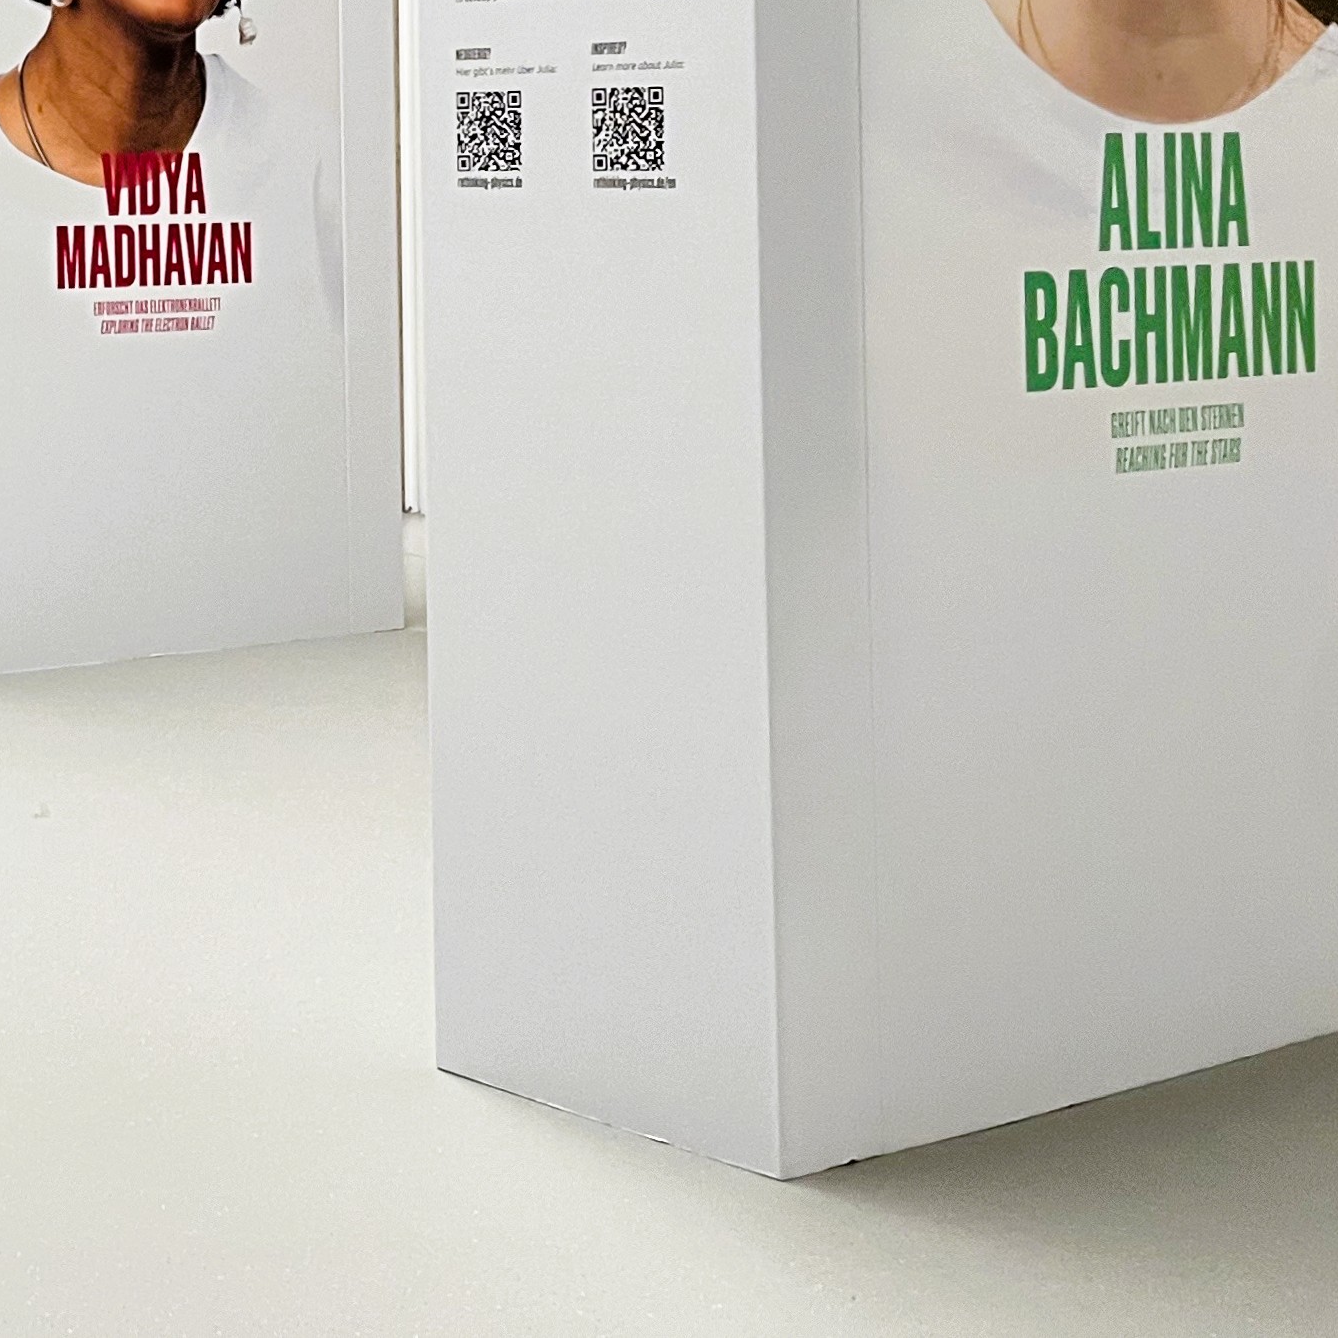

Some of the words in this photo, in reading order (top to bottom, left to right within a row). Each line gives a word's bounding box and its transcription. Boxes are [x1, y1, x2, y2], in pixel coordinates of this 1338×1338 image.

[101, 152, 206, 216] VIDYA
[1099, 132, 1249, 251] ALINA
[56, 222, 252, 289] MADHAVAN
[1024, 260, 1316, 392] BACHMANN
[1111, 411, 1146, 438] GREIFT
[1149, 408, 1176, 434] NACH
[1178, 406, 1198, 432] DEN
[1201, 403, 1245, 430] STERNEN
[1116, 444, 1166, 474] REACHING
[1169, 442, 1188, 468] FOR
[1191, 440, 1209, 466] THE
[1210, 437, 1242, 464] STARS
